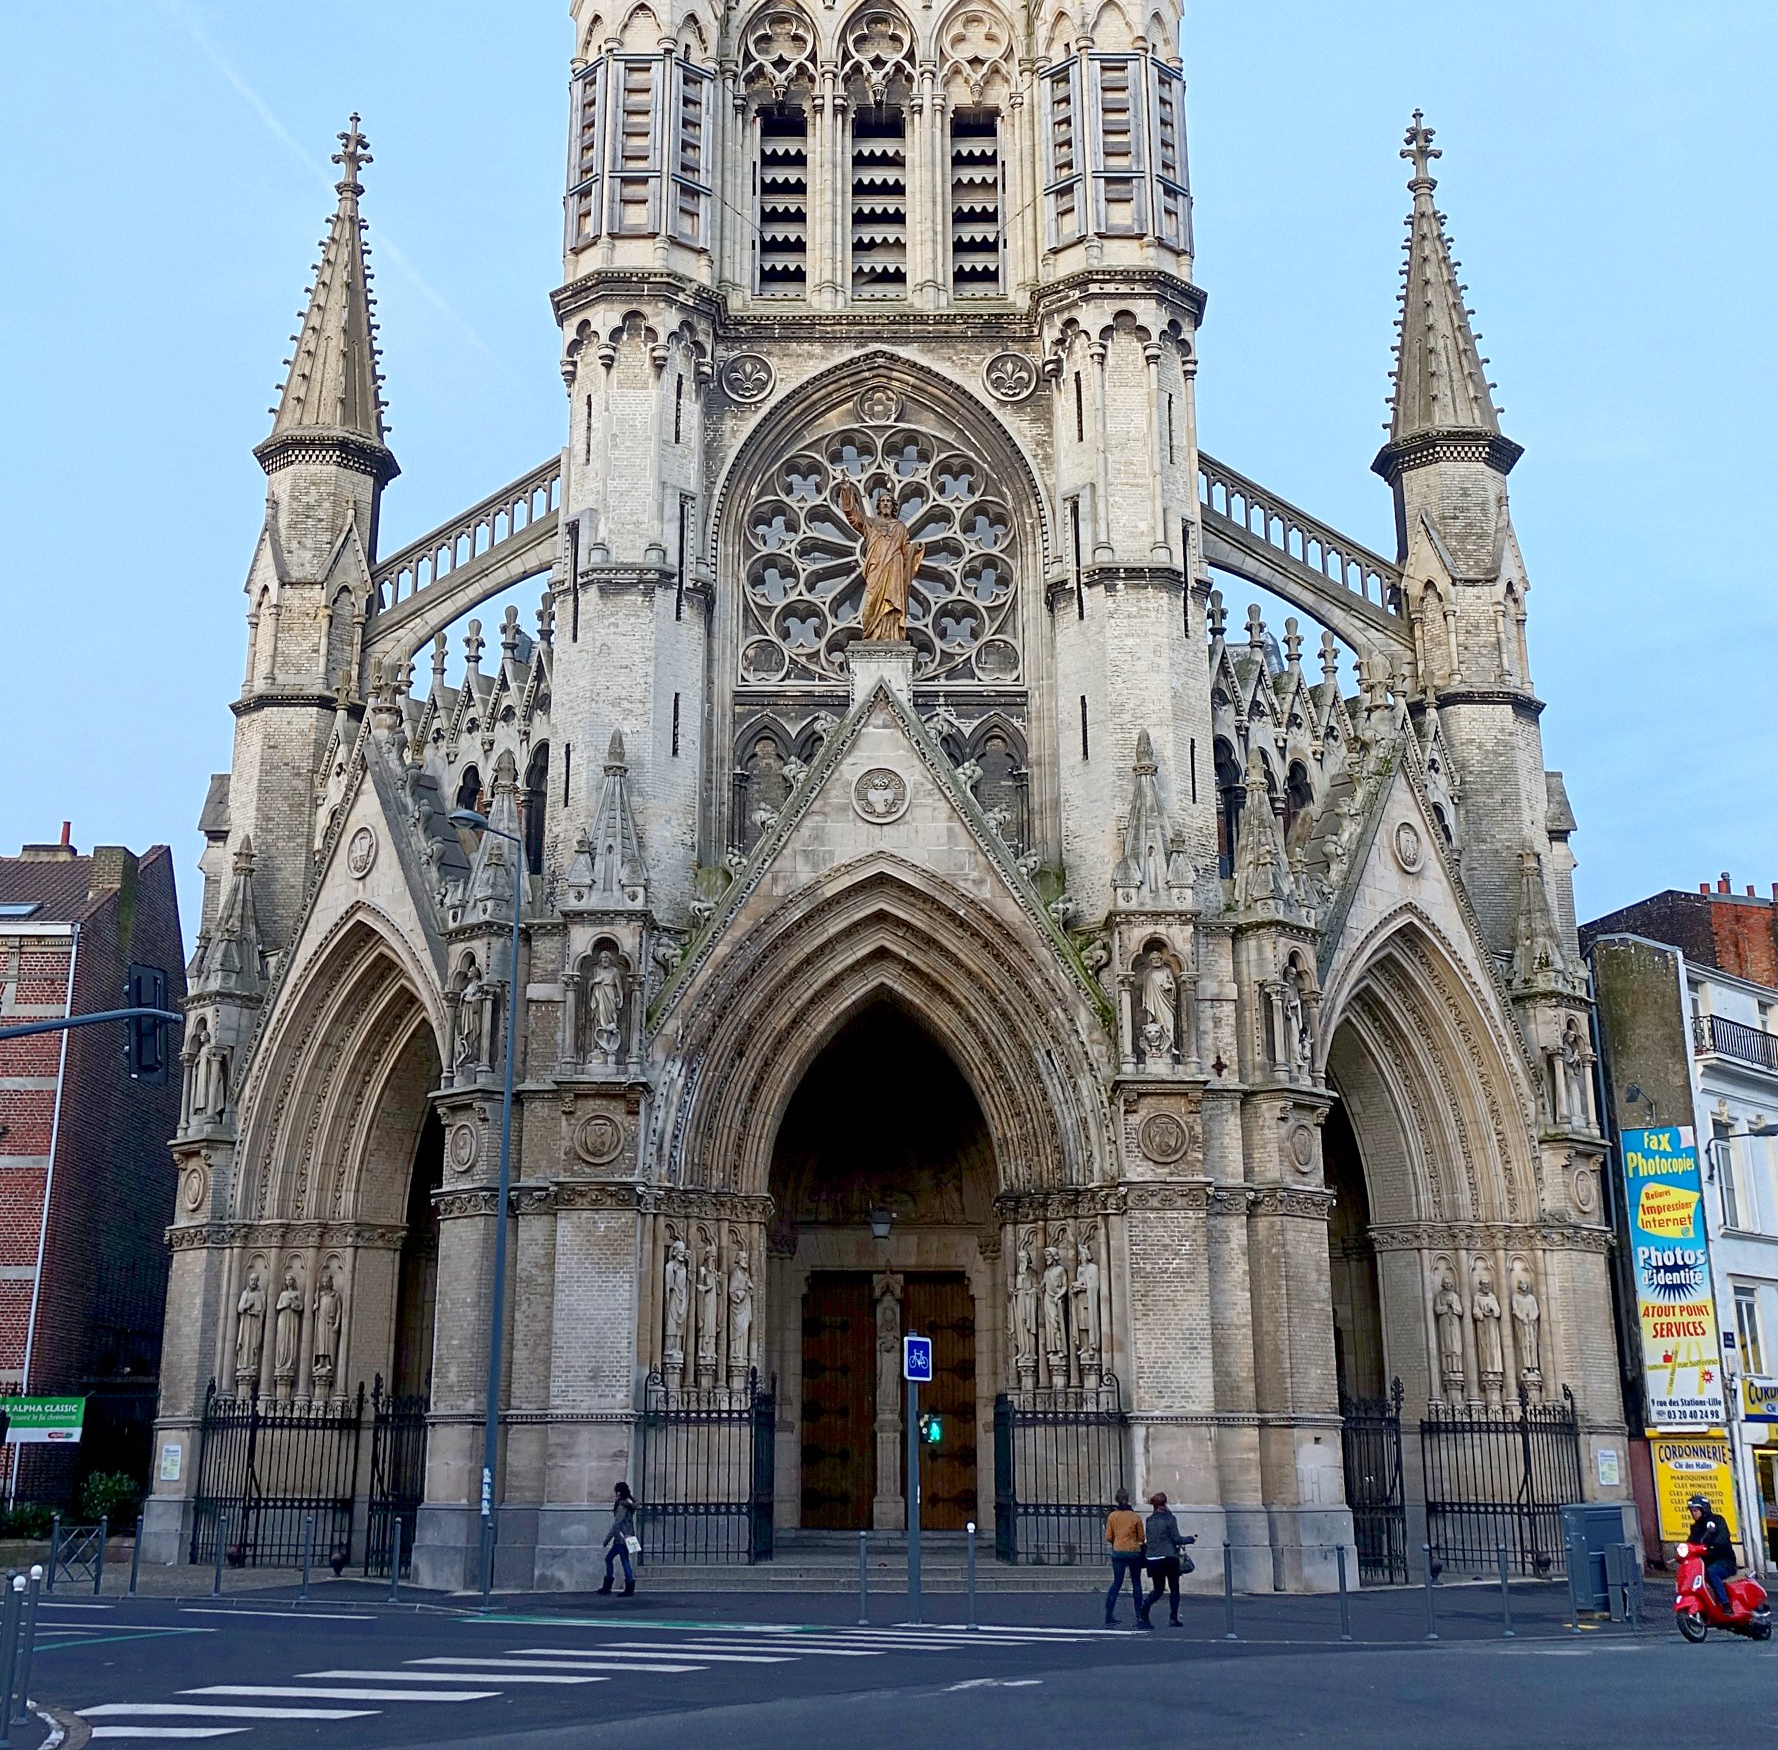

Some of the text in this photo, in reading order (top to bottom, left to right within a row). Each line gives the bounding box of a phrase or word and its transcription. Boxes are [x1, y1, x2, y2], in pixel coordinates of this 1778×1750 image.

[1643, 1131, 1672, 1152] Fax
[1626, 1151, 1695, 1178] Photocopies
[1644, 1189, 1671, 1201] Reliures
[1641, 1201, 1692, 1216] Impressions
[1641, 1213, 1692, 1229] Internet
[1637, 1246, 1706, 1267] Photos
[1642, 1304, 1710, 1318] ATOUT POINT
[1652, 1320, 1706, 1339] SERVICES
[13, 1404, 43, 1412] ALPHA
[44, 1404, 78, 1412] CLASSIC
[1651, 1398, 1655, 1407] 9
[1668, 1398, 1680, 1407] des
[1680, 1397, 1722, 1407] Stations-Lille
[1667, 1410, 1719, 1419] 03 20 40 24 98
[1659, 1444, 1727, 1465] CORDONNERIE
[1696, 1461, 1713, 1469] Halles
